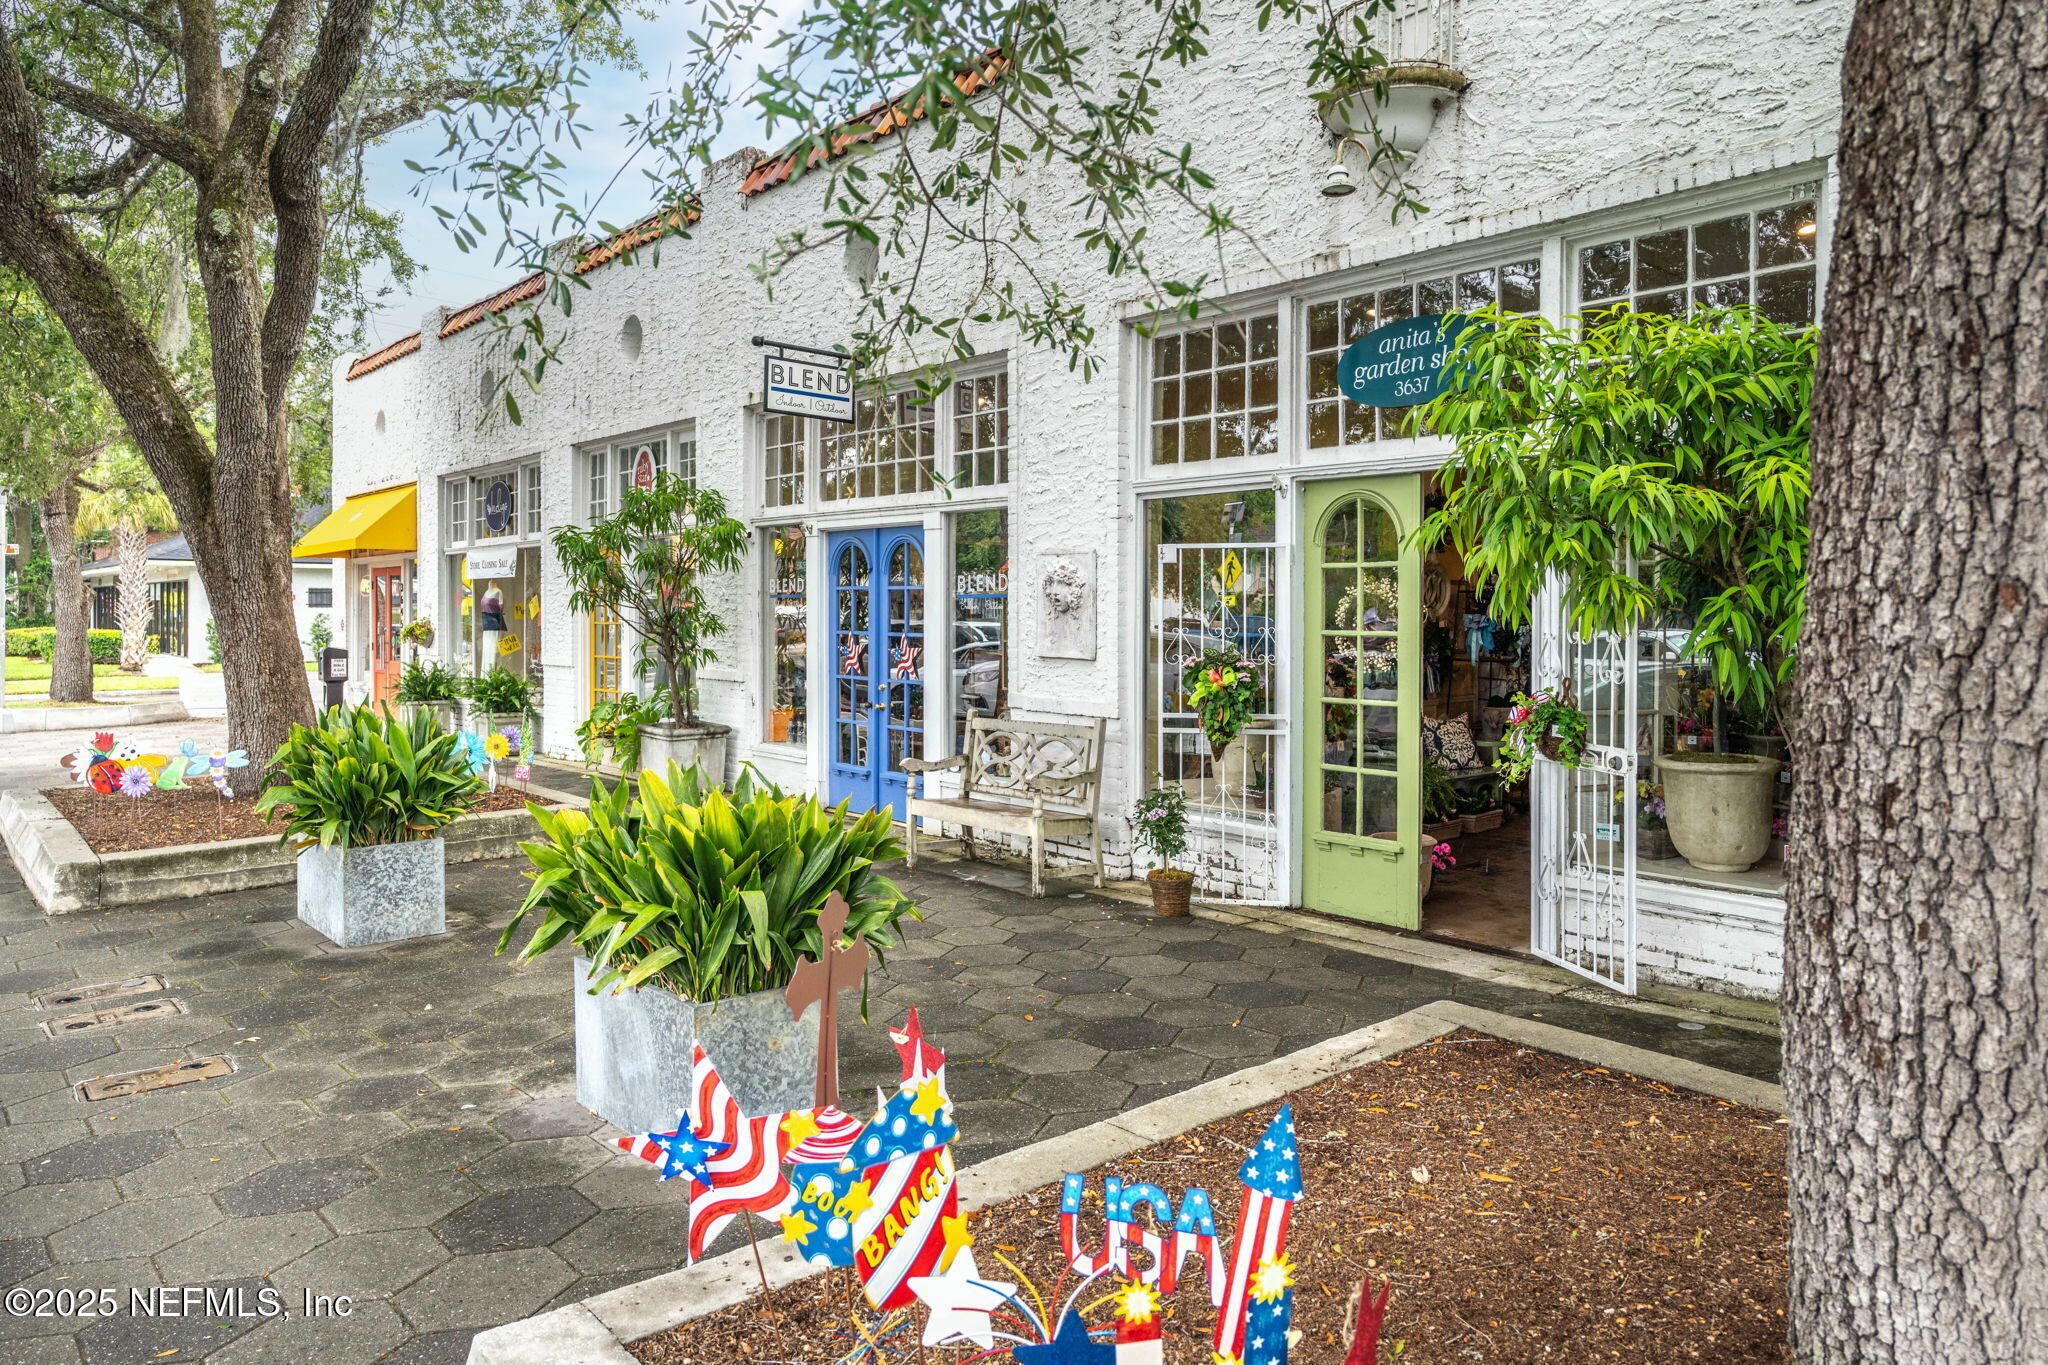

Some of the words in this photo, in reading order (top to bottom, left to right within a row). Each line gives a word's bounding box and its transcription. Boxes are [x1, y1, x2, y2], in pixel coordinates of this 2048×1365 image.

[1379, 321, 1446, 354] anita's
[771, 363, 851, 395] BLEND
[1353, 353, 1425, 389] garden
[1394, 375, 1430, 397] 3637
[775, 394, 807, 409] Indoor
[814, 399, 848, 415] Outdoor
[769, 578, 805, 593] BLEND
[957, 573, 1008, 593] BLEND
[802, 1182, 856, 1223] BOO
[862, 1151, 949, 1268] BANG!
[1059, 1173, 1228, 1308] USA
